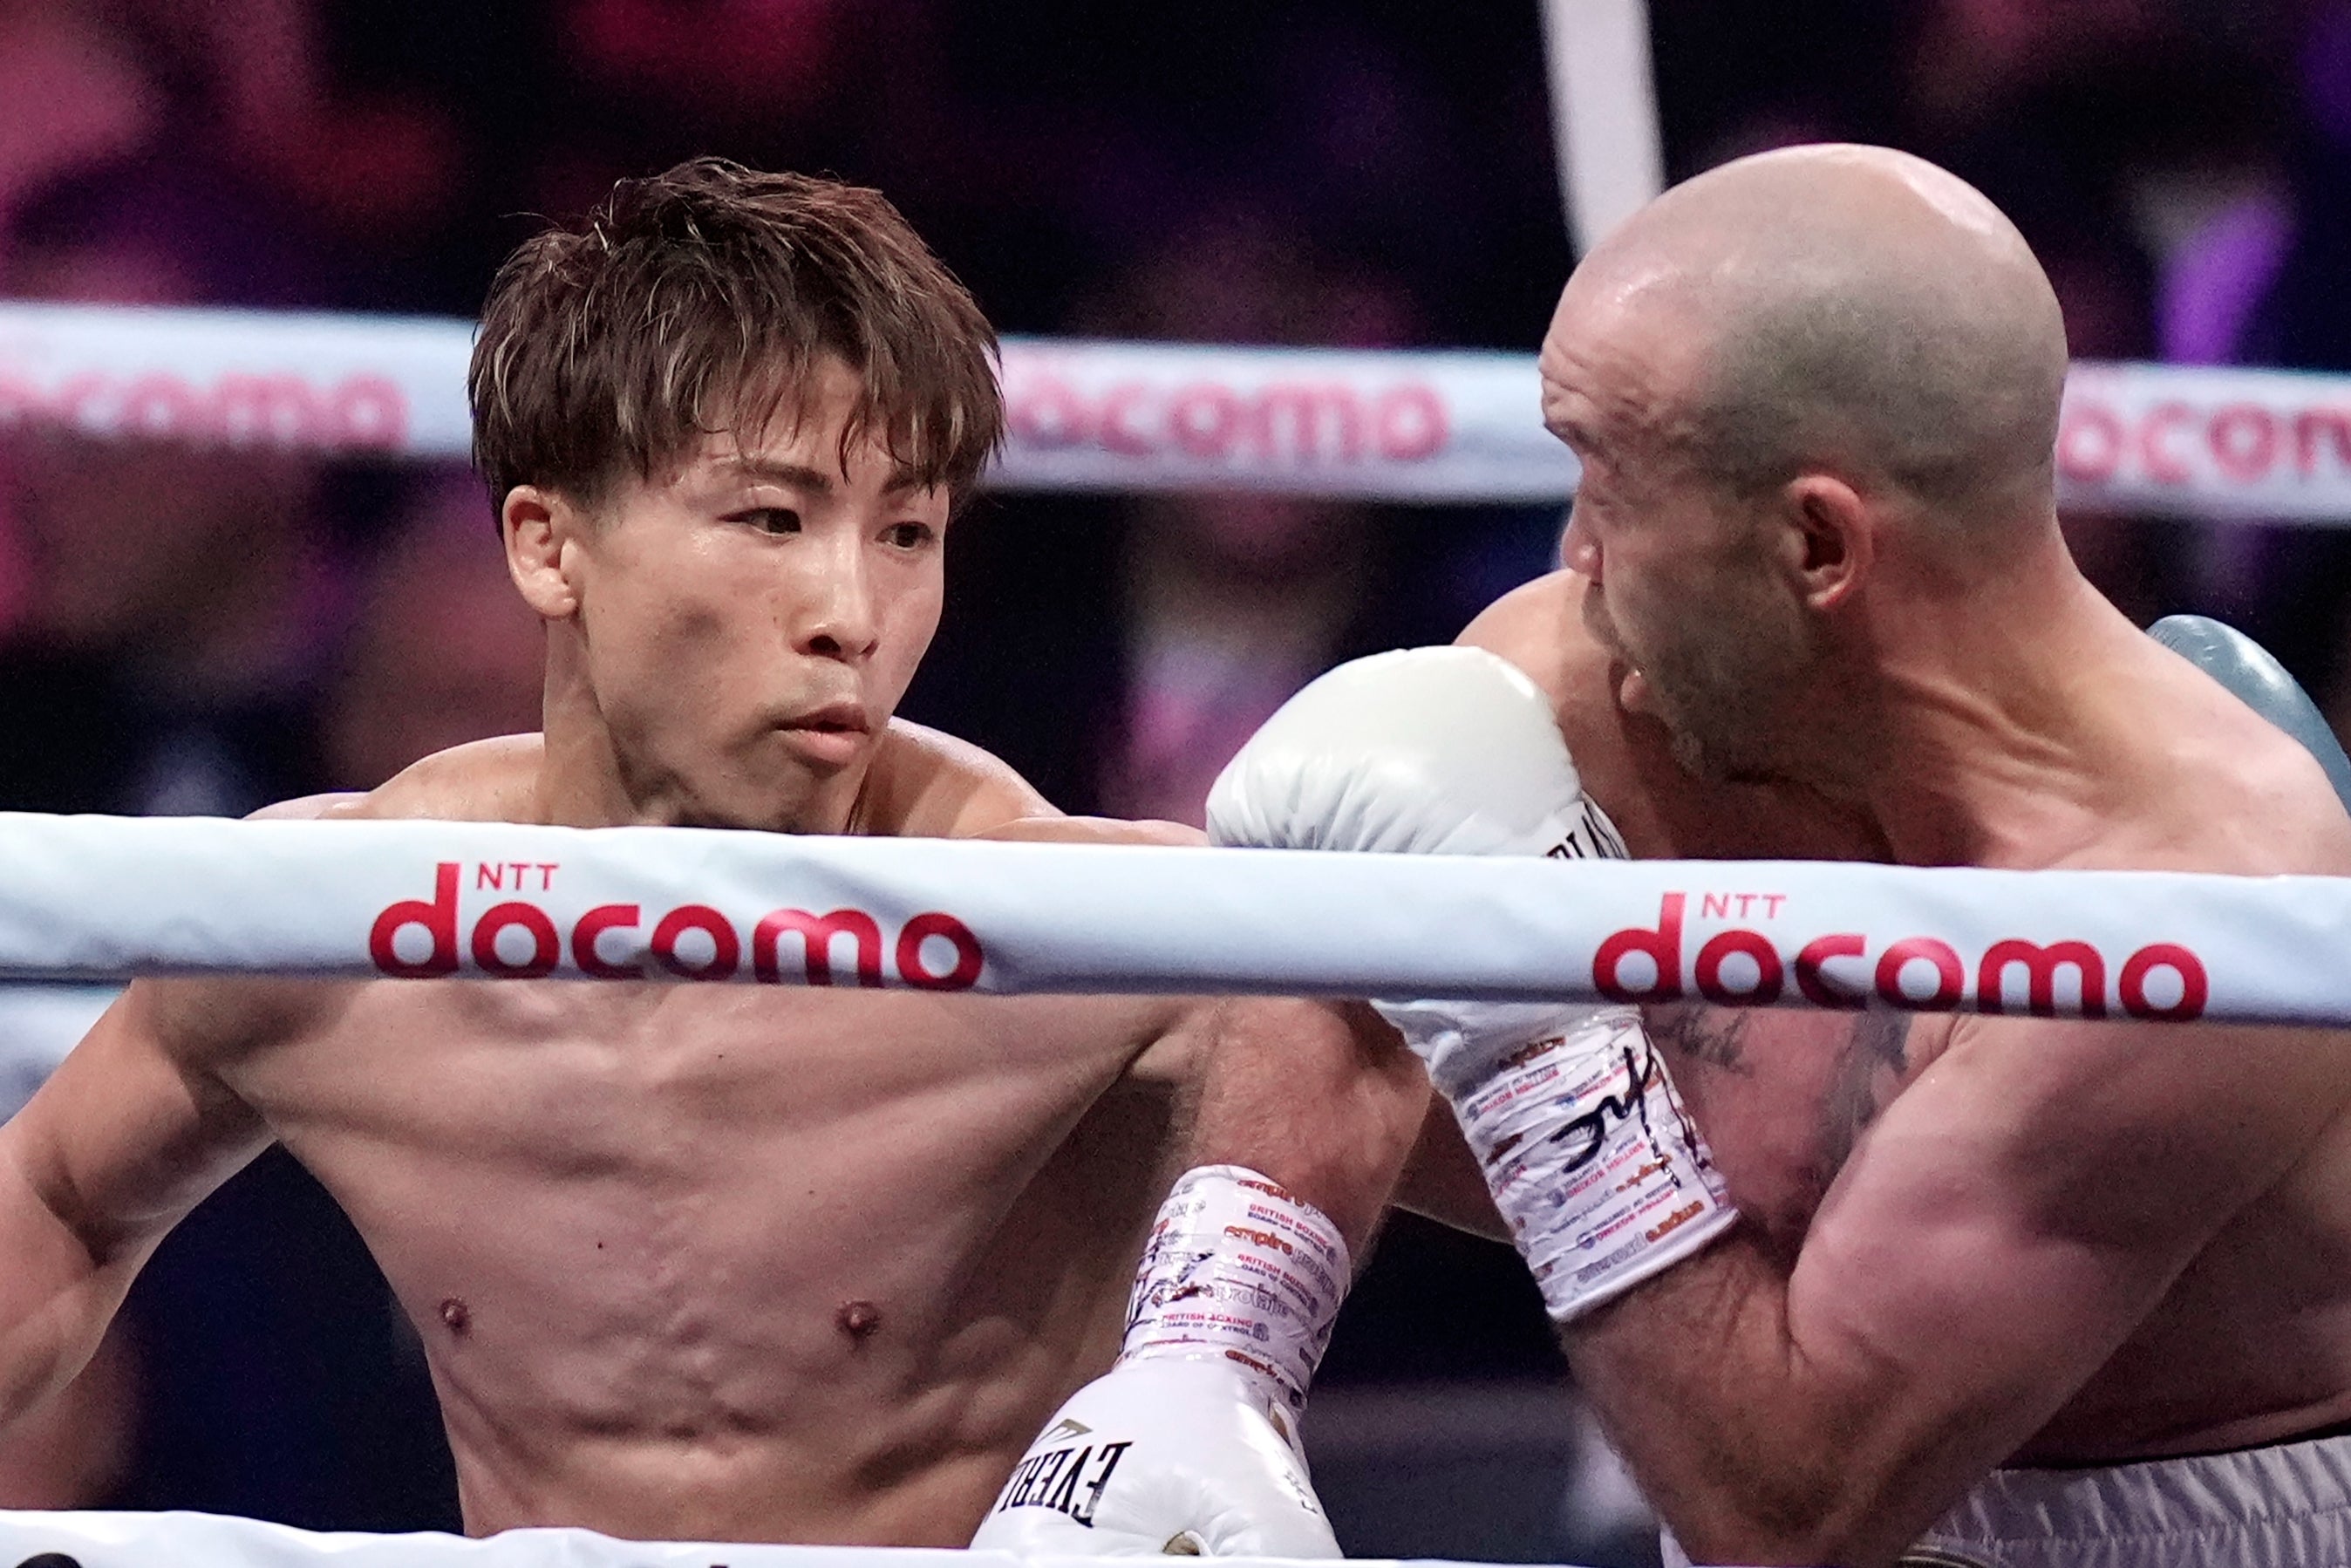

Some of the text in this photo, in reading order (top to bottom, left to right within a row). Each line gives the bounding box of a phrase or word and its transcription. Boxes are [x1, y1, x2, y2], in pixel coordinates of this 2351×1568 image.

[1005, 377, 1452, 462] ocomo
[476, 862, 559, 890] NTT
[1701, 893, 1787, 919] NTT
[370, 862, 984, 991] docomo
[1592, 891, 2208, 1022] docomo
[1224, 1224, 1293, 1256] empire
[1240, 1263, 1267, 1277] OARD
